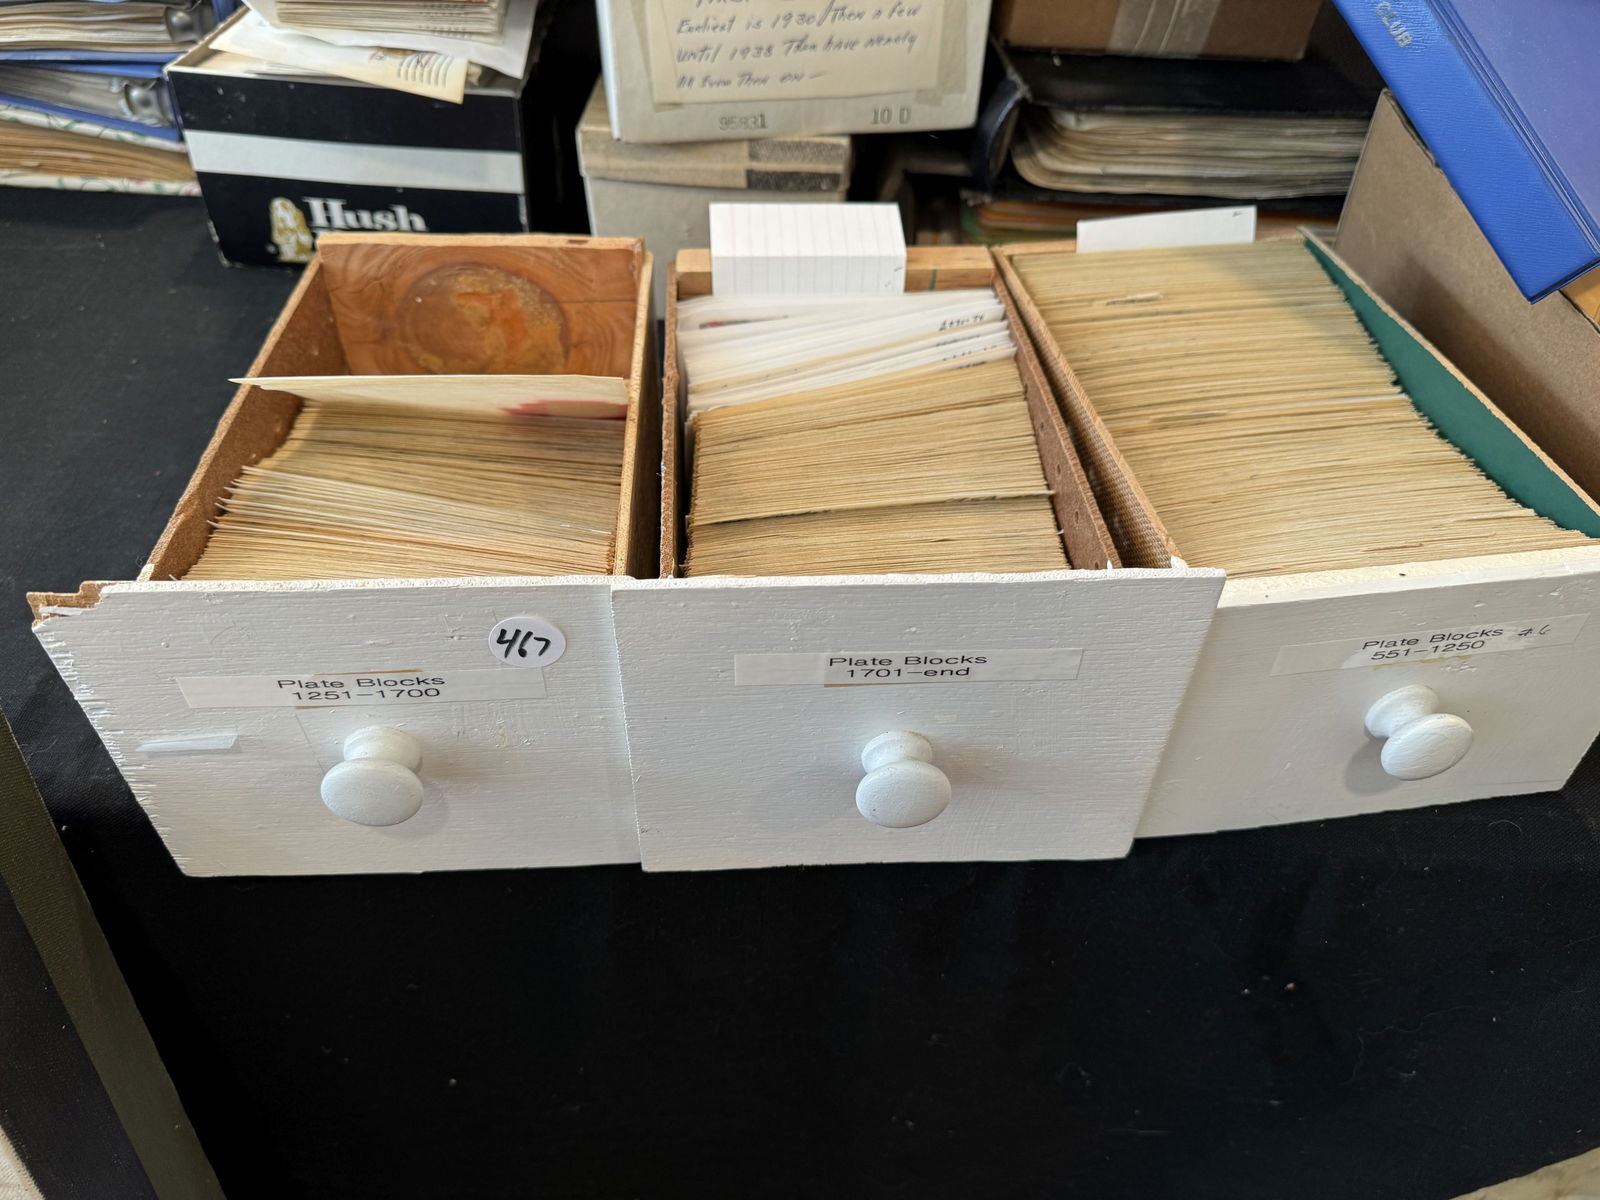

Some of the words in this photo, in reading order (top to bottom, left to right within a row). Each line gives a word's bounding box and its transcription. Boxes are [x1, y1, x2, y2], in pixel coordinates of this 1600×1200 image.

[1376, 1, 1414, 48] CLUB
[822, 35, 861, 52] have
[302, 196, 431, 233] Hush
[495, 627, 552, 659] 467
[1361, 637, 1420, 651] Plate
[1428, 627, 1504, 644] Blocks
[1370, 639, 1486, 661] 551-1250
[829, 656, 893, 667] Plate
[904, 655, 988, 666] Blocks
[847, 666, 971, 679] 1701-end
[276, 678, 345, 690] Plate
[355, 675, 446, 689] Blocks
[292, 686, 441, 701] 1251-1700
